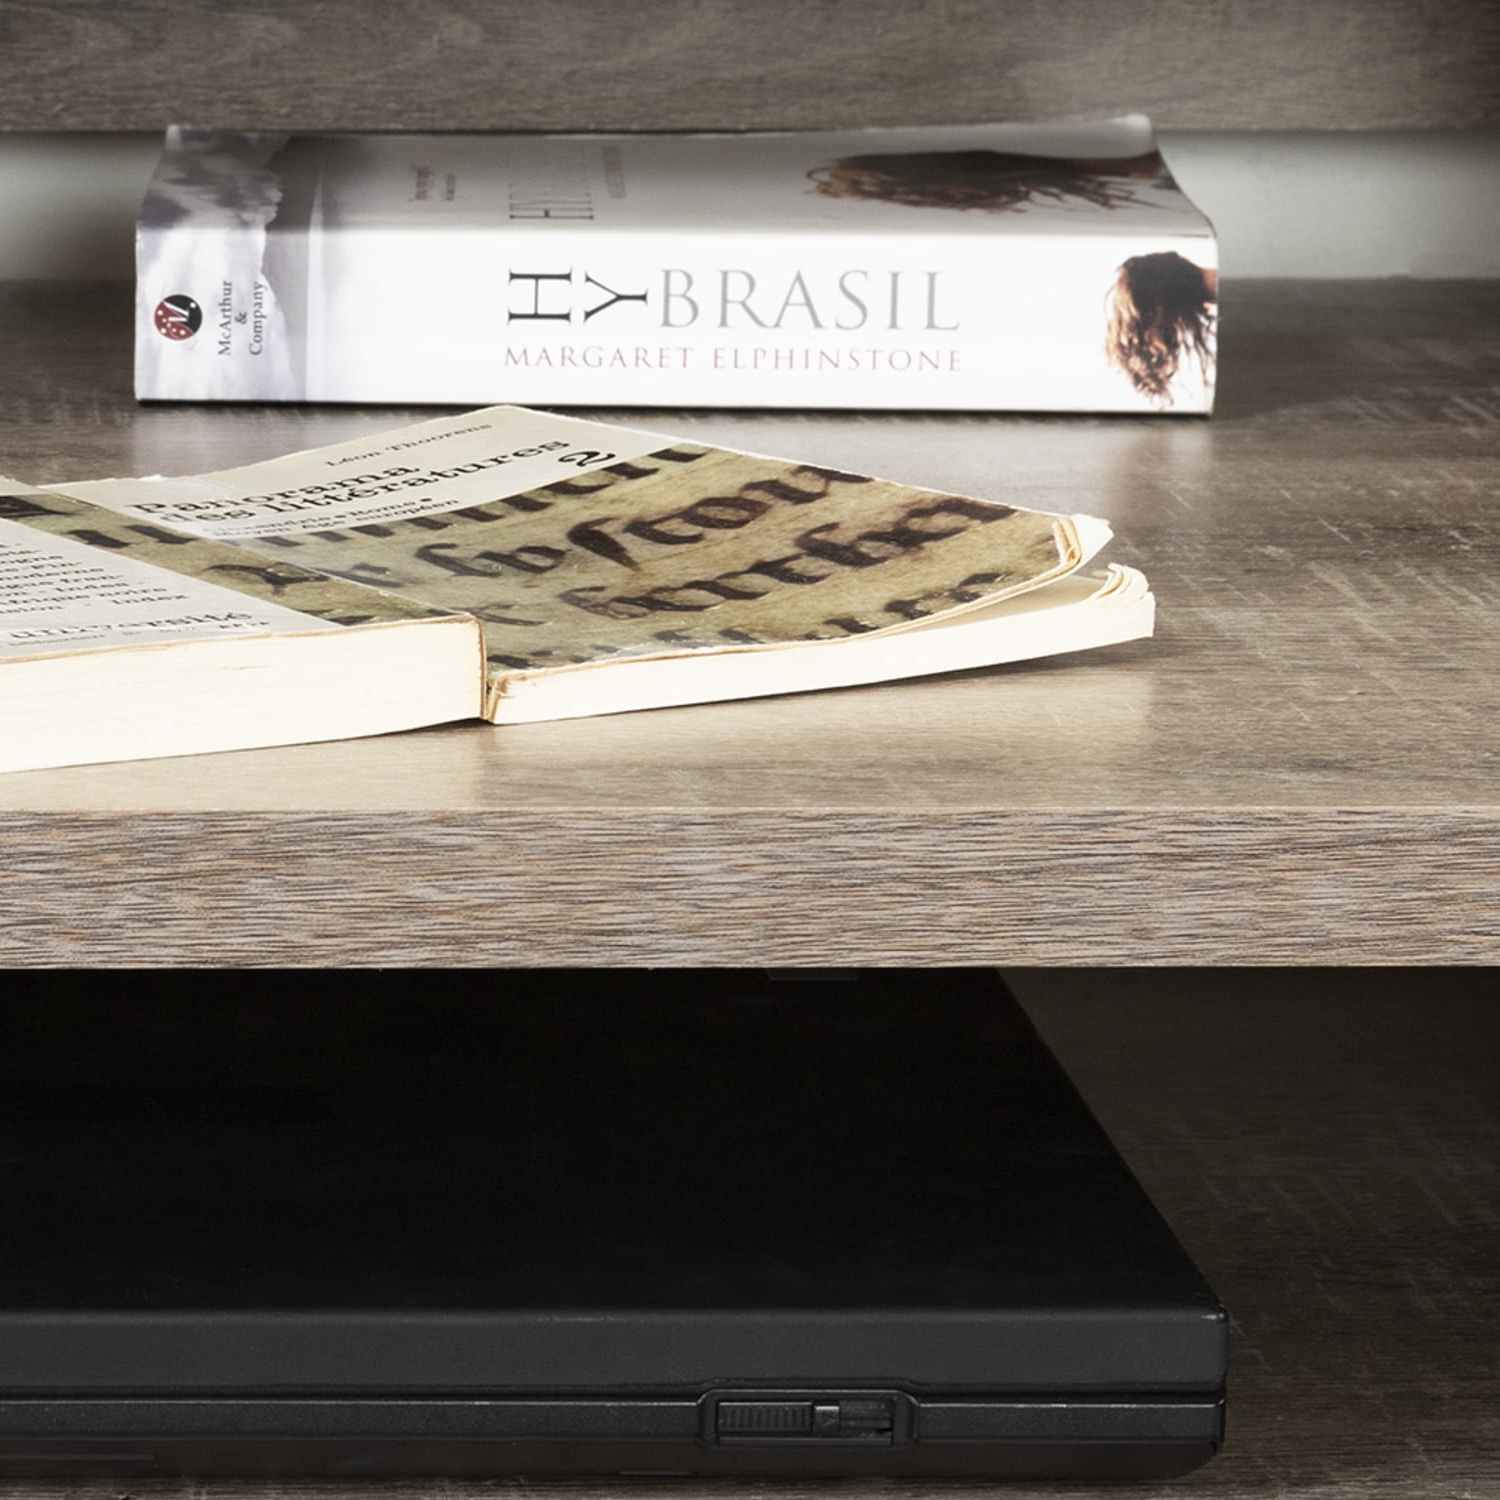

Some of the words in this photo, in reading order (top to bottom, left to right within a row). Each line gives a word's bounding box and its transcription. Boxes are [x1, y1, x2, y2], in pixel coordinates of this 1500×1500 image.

[217, 281, 233, 356] McArthur
[235, 311, 248, 325] &
[249, 281, 268, 356] Company
[503, 345, 693, 370] MARGARET
[712, 348, 962, 373] ELPHINSTONE
[160, 508, 258, 524] des
[264, 440, 570, 513] littératures
[558, 451, 616, 467] 2
[127, 464, 421, 514] Panorama
